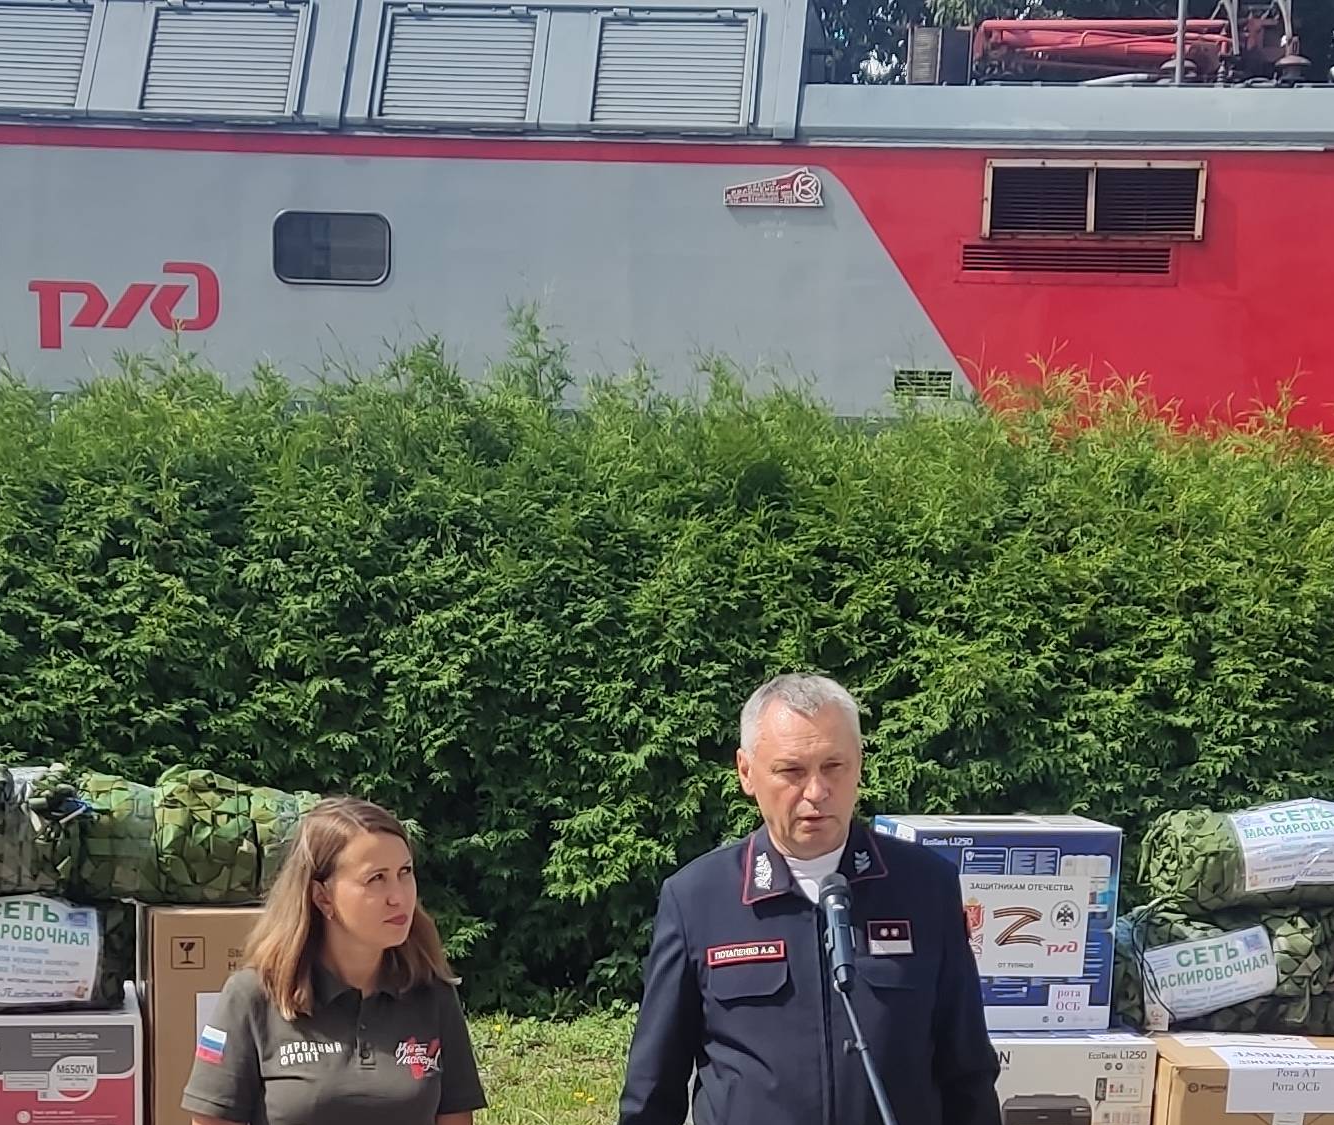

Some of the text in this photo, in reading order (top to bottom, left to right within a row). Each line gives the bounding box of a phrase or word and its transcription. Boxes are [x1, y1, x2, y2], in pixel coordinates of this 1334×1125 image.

[949, 836, 974, 846] L1250
[969, 882, 1075, 892] ЗАЩИТНИКАМ ОТЕЧЕСТВА
[993, 906, 1046, 946] Z
[1175, 942, 1240, 968] СЕТЬ
[1157, 953, 1270, 991] АСКИРОВОЧНАЯ
[1057, 989, 1081, 999] рота
[1055, 1001, 1081, 1011] ОСБ
[1088, 1051, 1148, 1060] EcoTank L1250
[56, 1064, 95, 1075] M6507W
[1276, 1067, 1317, 1078] Рота АТ
[1271, 1081, 1321, 1092] Рота ОСБ
